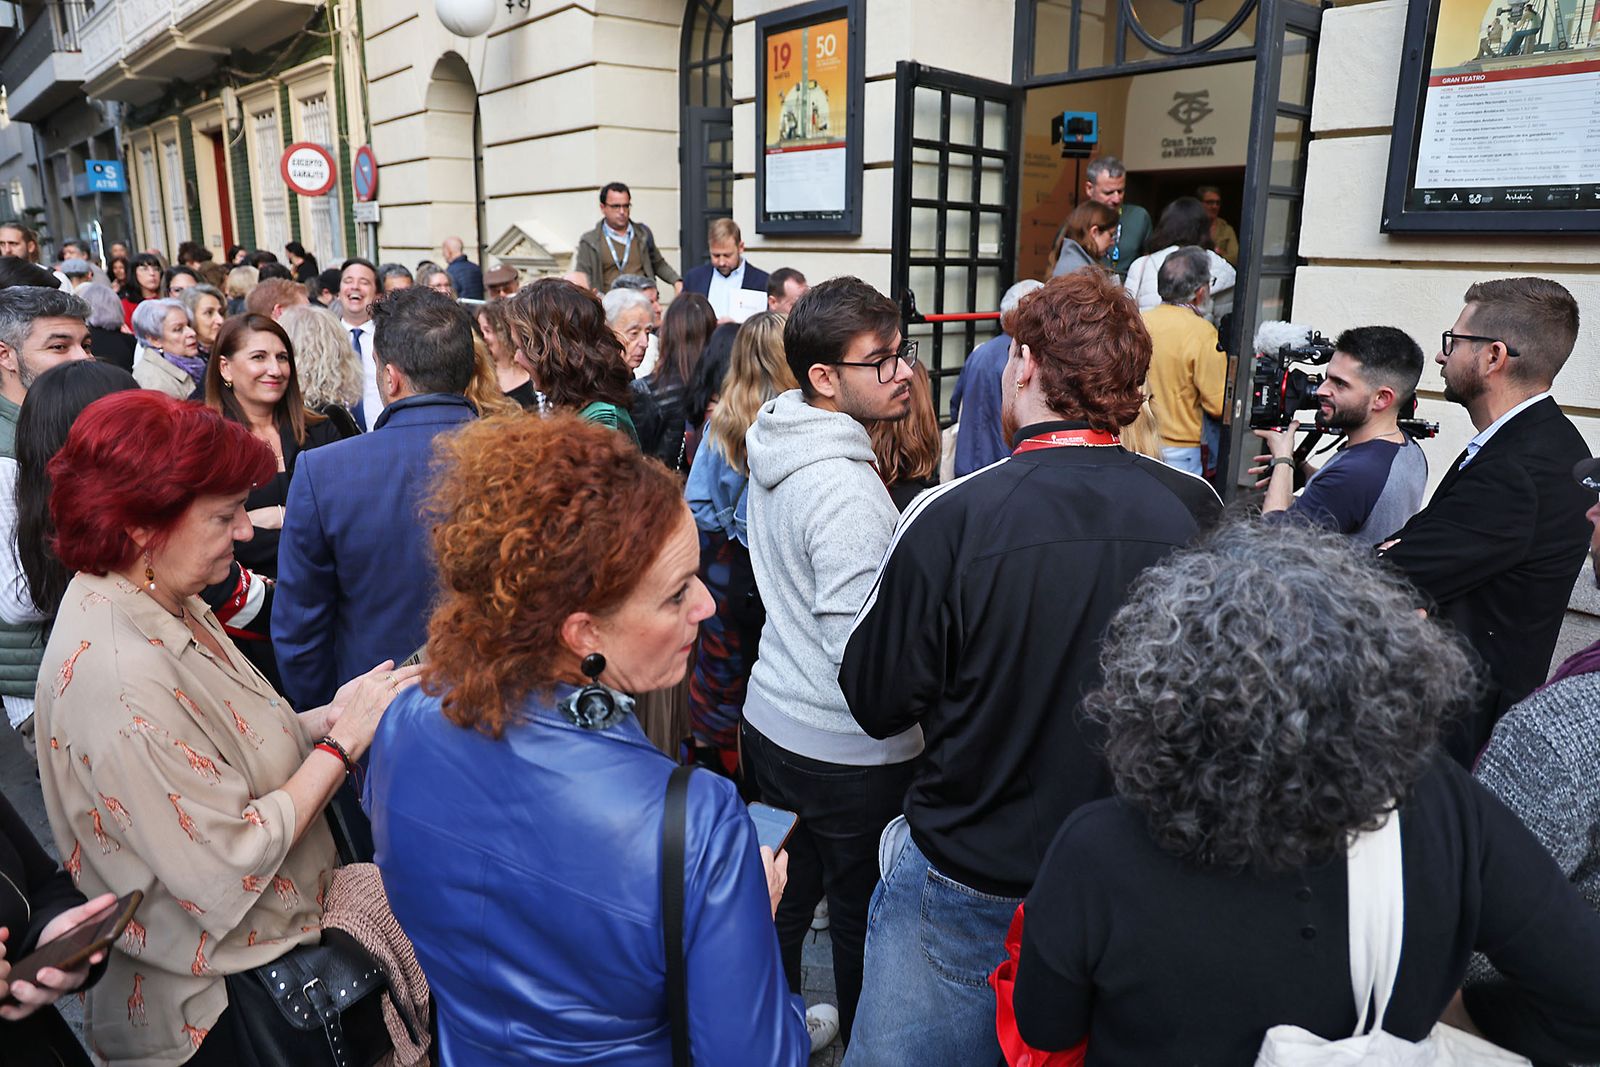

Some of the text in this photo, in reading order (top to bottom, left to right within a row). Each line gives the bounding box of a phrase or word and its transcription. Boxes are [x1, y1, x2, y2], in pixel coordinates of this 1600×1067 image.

[816, 34, 836, 58] 50
[773, 42, 792, 72] 19
[1161, 136, 1217, 147] Gran Teatro
[1161, 147, 1215, 158] de HUELVA
[104, 165, 117, 179] S
[96, 179, 118, 189] ATM
